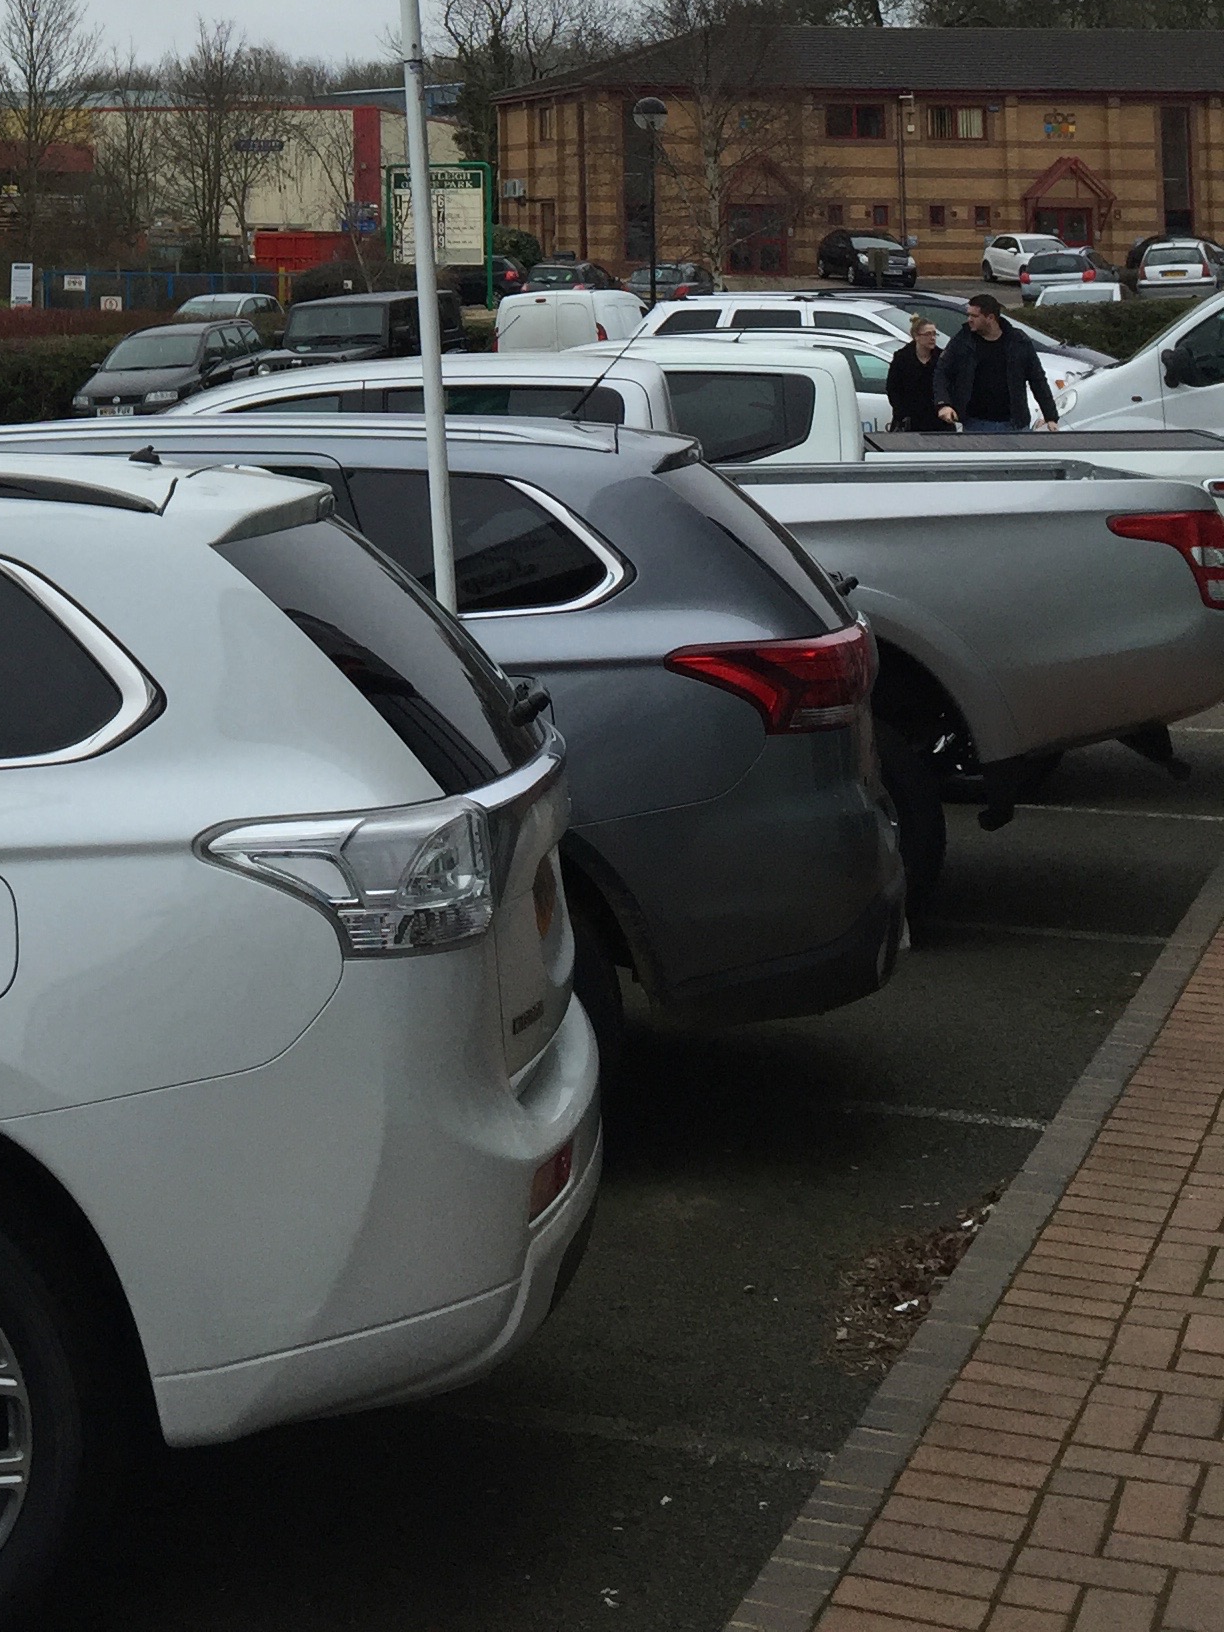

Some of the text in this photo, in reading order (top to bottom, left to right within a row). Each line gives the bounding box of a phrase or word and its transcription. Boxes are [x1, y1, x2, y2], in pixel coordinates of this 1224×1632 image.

[444, 180, 474, 188] PARK
[437, 194, 445, 207] 6
[437, 209, 445, 221] 7
[437, 222, 445, 234] 8
[437, 236, 445, 248] 9
